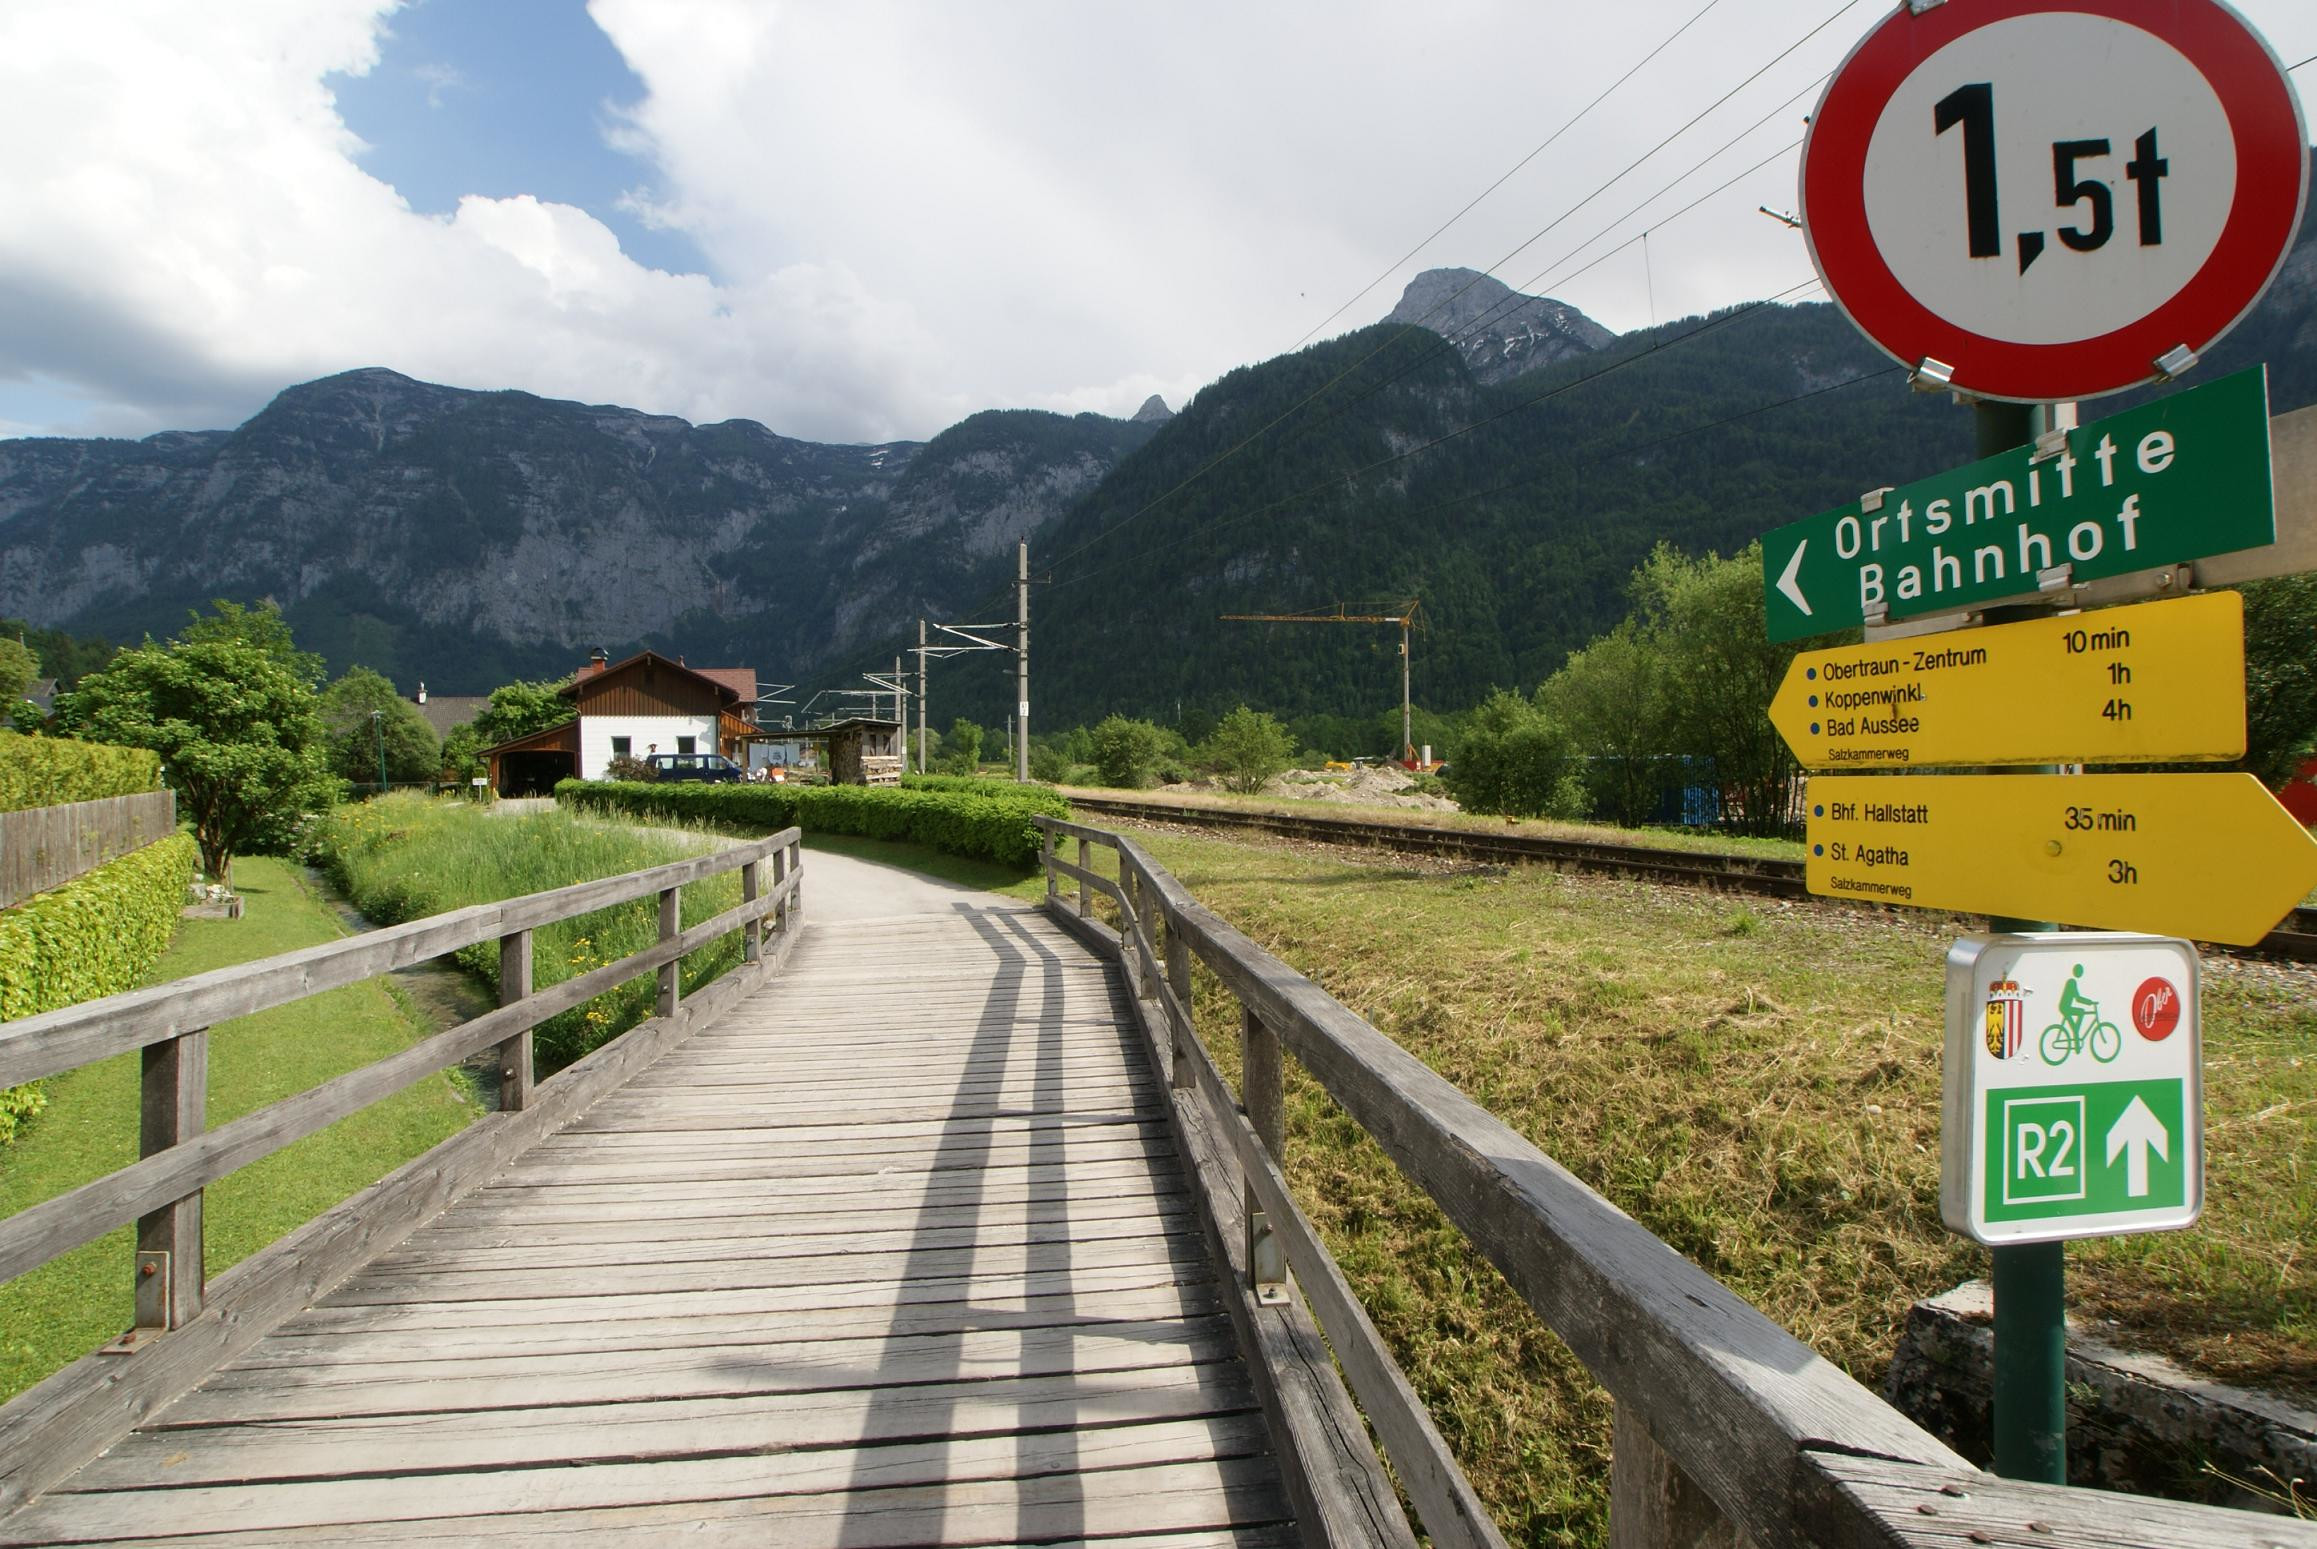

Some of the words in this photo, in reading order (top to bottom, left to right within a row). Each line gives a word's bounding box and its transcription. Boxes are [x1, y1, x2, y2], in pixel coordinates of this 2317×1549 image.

[1934, 82, 2168, 276] 1,5t
[1835, 430, 2175, 560] Ortsmitte
[1860, 494, 2140, 608] Bahnhof
[2062, 630, 2087, 653] 10
[2091, 627, 2130, 651] min
[1823, 659, 1899, 681] Obertraun
[1913, 648, 1987, 672] Zentrum
[2107, 662, 2131, 684] 1h
[1825, 683, 1921, 711] Koppenwinkl
[2102, 698, 2132, 721] 4h
[1827, 717, 1855, 736] Bad
[1860, 717, 1920, 735] Aussee
[1828, 748, 1909, 761] Salzkammerweg
[1831, 802, 1859, 821] Bhf.
[1864, 803, 1929, 824] Hallstatt
[2064, 806, 2094, 830] 35
[2098, 808, 2136, 832] min
[1831, 842, 1850, 861] St.
[1855, 844, 1909, 867] Agatha
[2108, 859, 2138, 884] 3h
[1830, 876, 1912, 900] Salzkammerweg
[2017, 1119, 2075, 1180] R2
